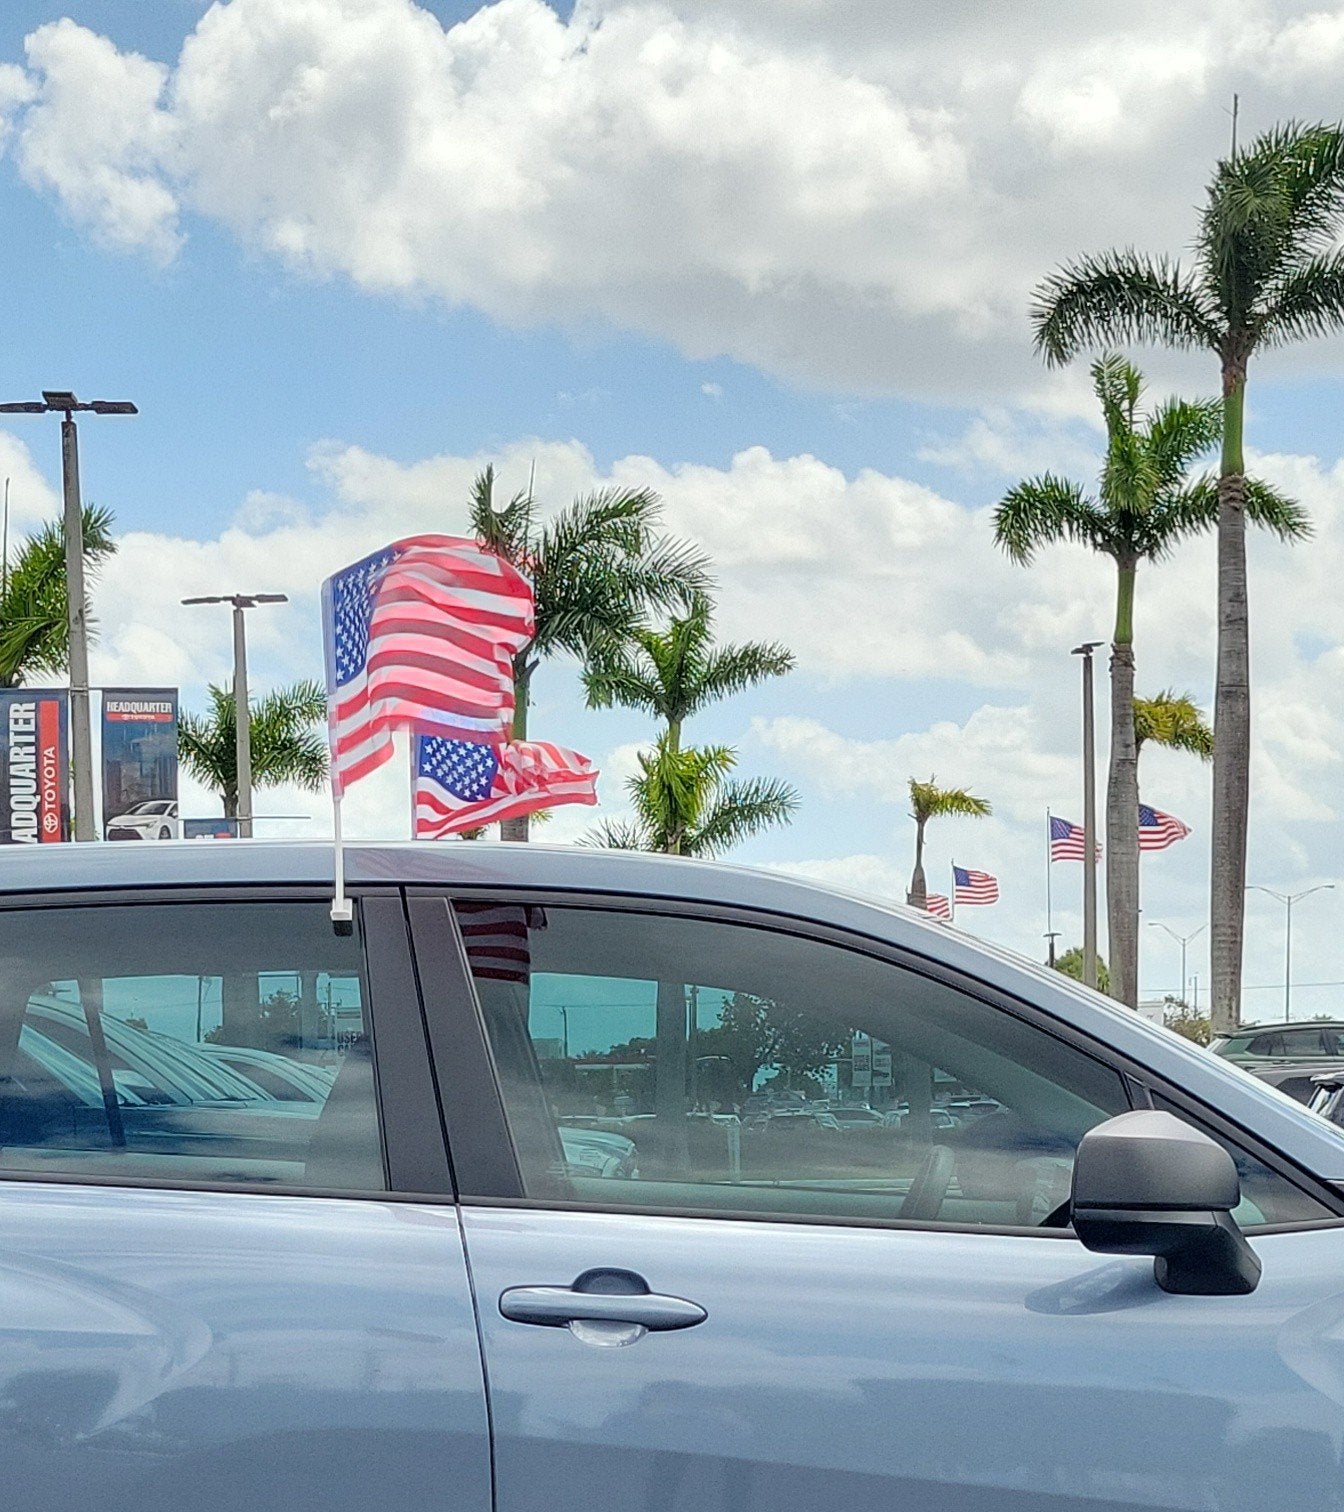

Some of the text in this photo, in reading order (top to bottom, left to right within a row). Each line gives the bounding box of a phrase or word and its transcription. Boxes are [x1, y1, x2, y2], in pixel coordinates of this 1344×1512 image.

[106, 701, 173, 714] HEADQUARTER
[9, 702, 41, 844] ADQUARTER
[43, 746, 56, 811] TOYOTA
